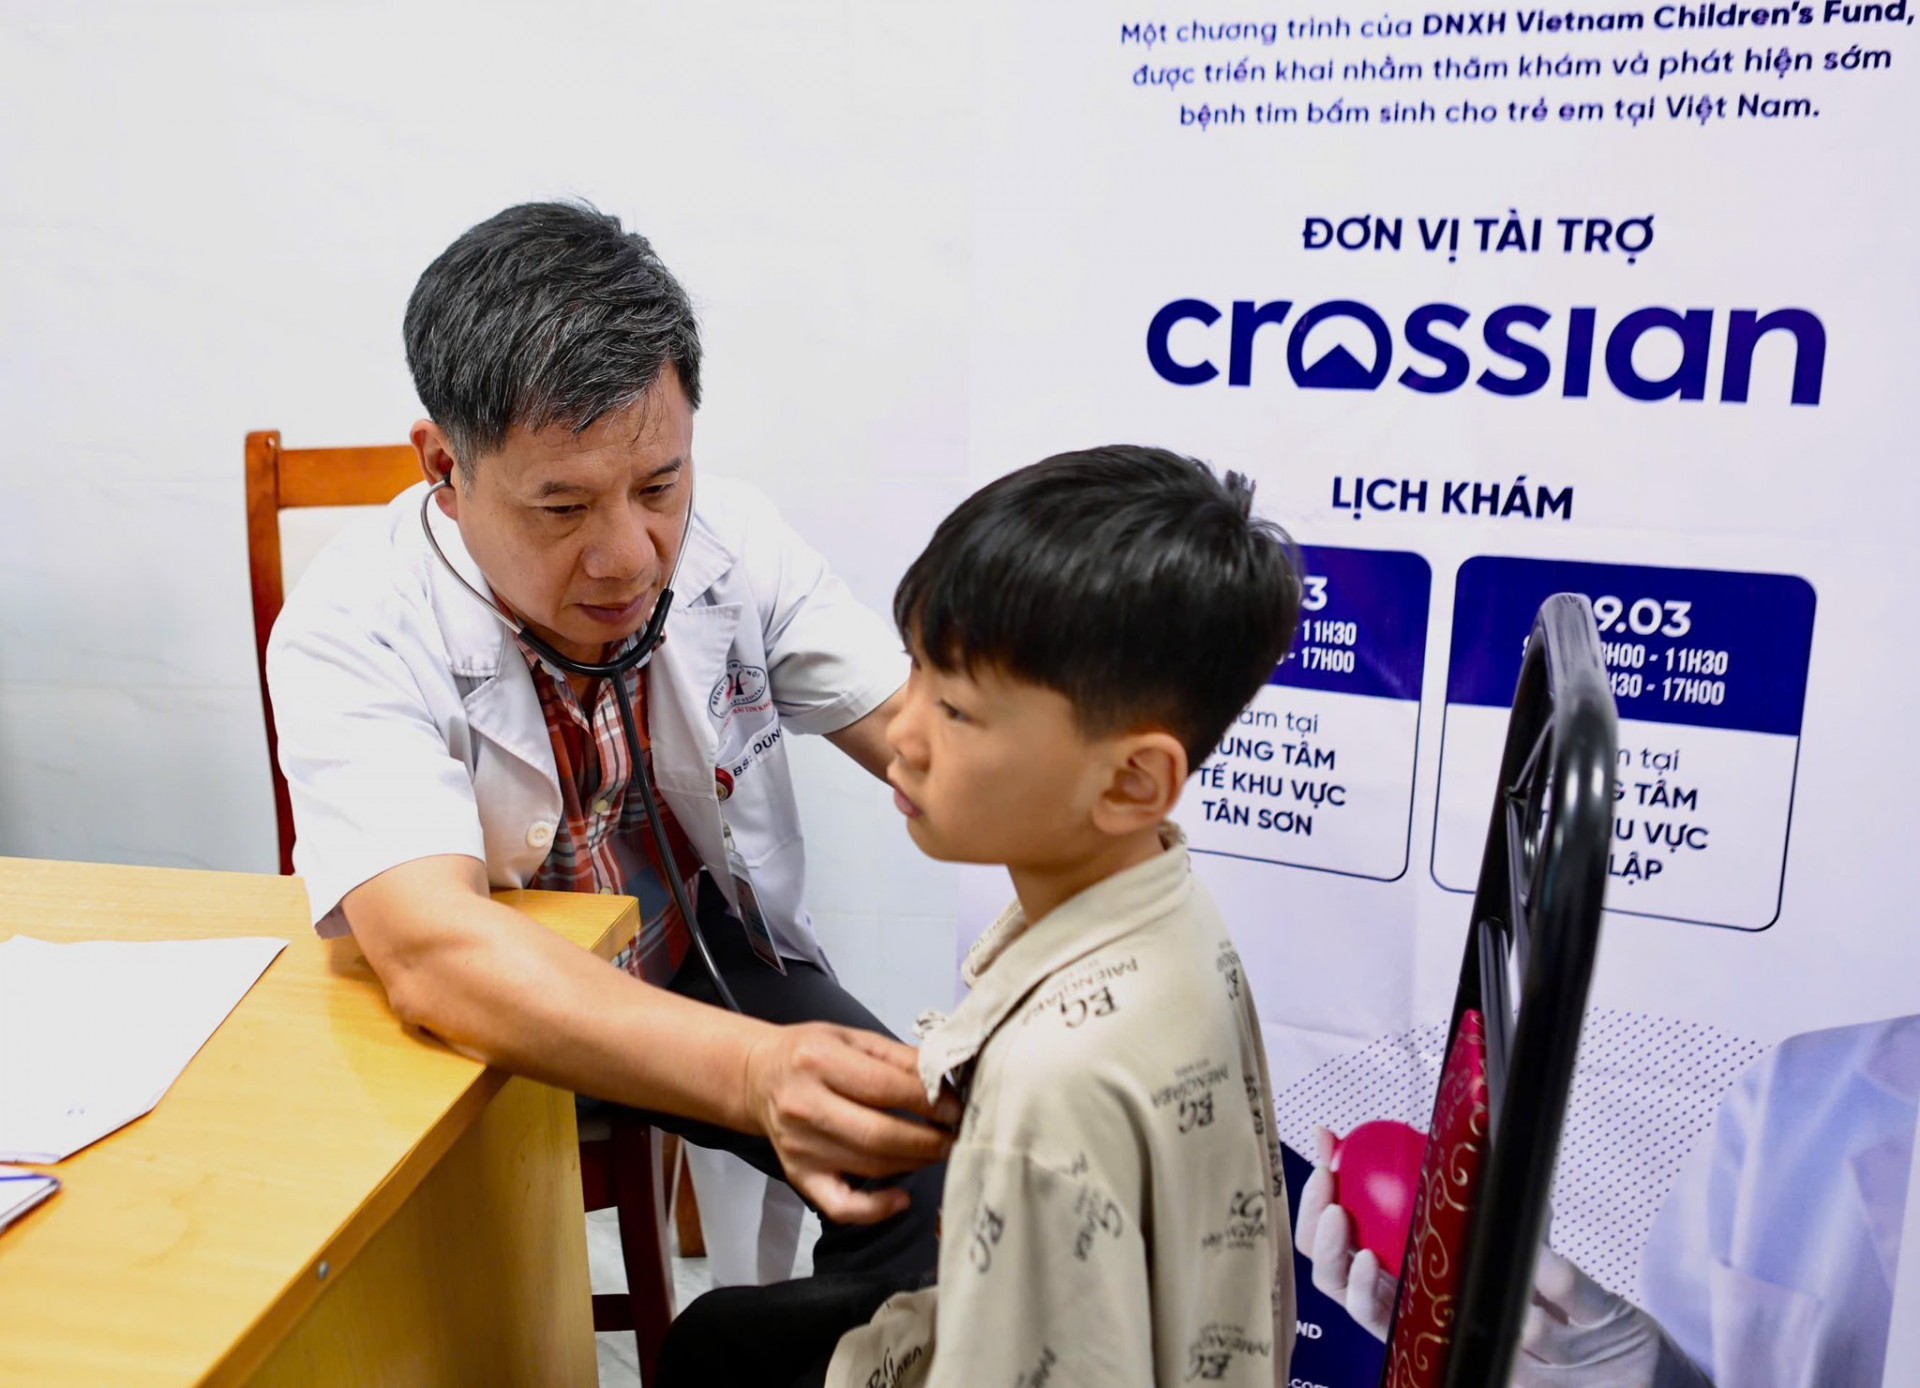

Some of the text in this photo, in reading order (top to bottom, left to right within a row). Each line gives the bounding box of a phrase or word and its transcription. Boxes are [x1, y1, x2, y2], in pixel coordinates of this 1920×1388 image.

[1121, 22, 1167, 50] Một
[1176, 20, 1278, 45] chương
[1287, 16, 1351, 39] trình
[1360, 13, 1413, 38] của
[1422, 11, 1507, 36] DNXH
[1516, 9, 1645, 33] Vietnam
[1822, 0, 1915, 26] Fund,
[1132, 63, 1195, 91] được
[1275, 59, 1334, 81] khai
[1343, 55, 1423, 81] nhằm
[1433, 57, 1508, 79] thăm
[1518, 54, 1602, 78] khám
[1612, 51, 1649, 75] và
[1658, 49, 1734, 81] phát
[1744, 47, 1813, 79] hiện
[1823, 44, 1892, 71] sớm
[1179, 103, 1246, 131] bệnh
[1255, 102, 1298, 124] tim
[1380, 100, 1436, 123] sinh
[1445, 100, 1498, 123] cho
[1507, 97, 1549, 122] trẻ
[1558, 103, 1604, 121] em
[1614, 96, 1655, 127] tại
[1666, 95, 1727, 126] Việt
[1737, 93, 1820, 118] Nam.
[1301, 208, 1655, 266] ĐƠN VỊ TÀI TRỢ
[1145, 297, 1827, 407] crossian
[1331, 474, 1574, 521] LỊCH KHÁM
[1302, 618, 1358, 646] 11H30
[1593, 595, 1693, 638] 9.03
[1301, 646, 1356, 674] 17H00
[1664, 647, 1730, 677] 11H30
[1661, 676, 1727, 706] 17H00
[1237, 705, 1319, 739] ám tại
[753, 728, 781, 755] DŨN
[1219, 736, 1336, 771] UNG TÂM
[1640, 747, 1680, 776] tại
[1199, 761, 1347, 810] TẾ KHU VỰC
[1634, 779, 1698, 812] TÂM
[1201, 797, 1314, 837] TÂN SƠN
[1643, 821, 1709, 854] VỰC
[1608, 851, 1663, 886] LẬP
[1296, 1320, 1324, 1340] ND
